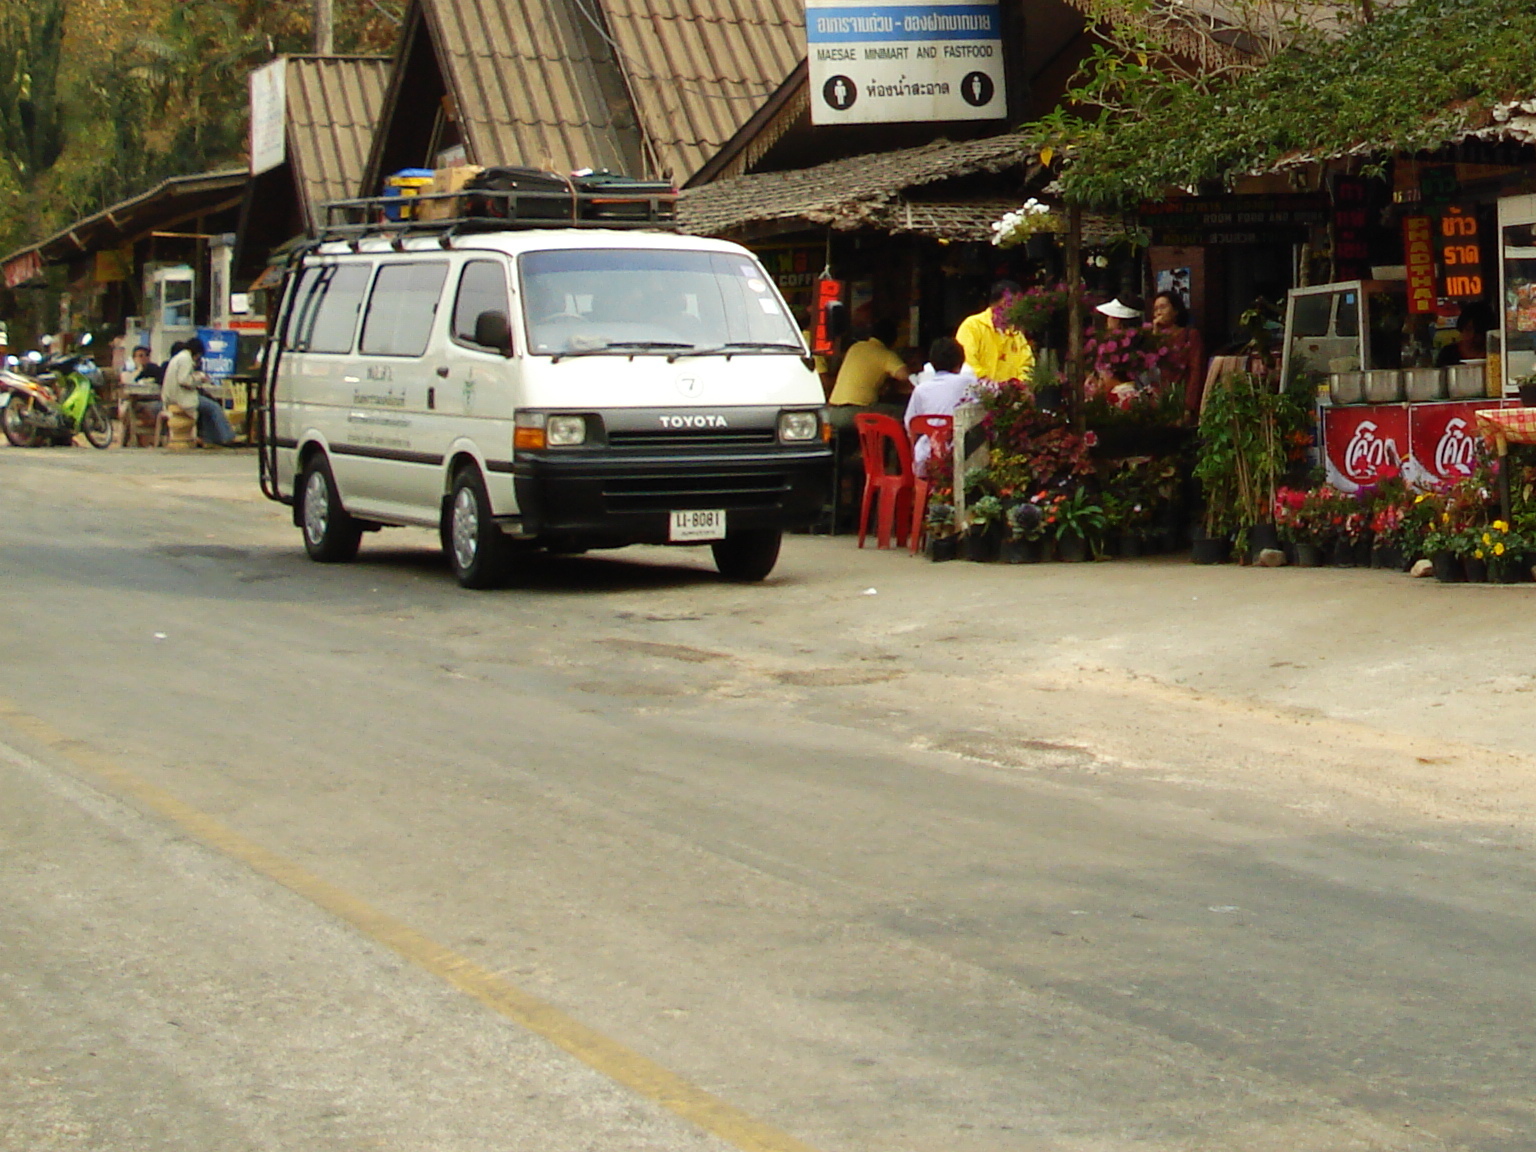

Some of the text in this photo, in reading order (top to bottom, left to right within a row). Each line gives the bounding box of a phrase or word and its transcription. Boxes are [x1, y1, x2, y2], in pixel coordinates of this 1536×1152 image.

[817, 45, 993, 61] MAESAE MINIMART AND FASTFOOD
[1203, 214, 1232, 225] ROOM
[1237, 213, 1264, 223] FOOD
[1269, 212, 1288, 221] AND
[1441, 206, 1478, 237] ข้าว
[1407, 217, 1433, 311] PHADTHAI
[659, 415, 728, 429] TOYOTA
